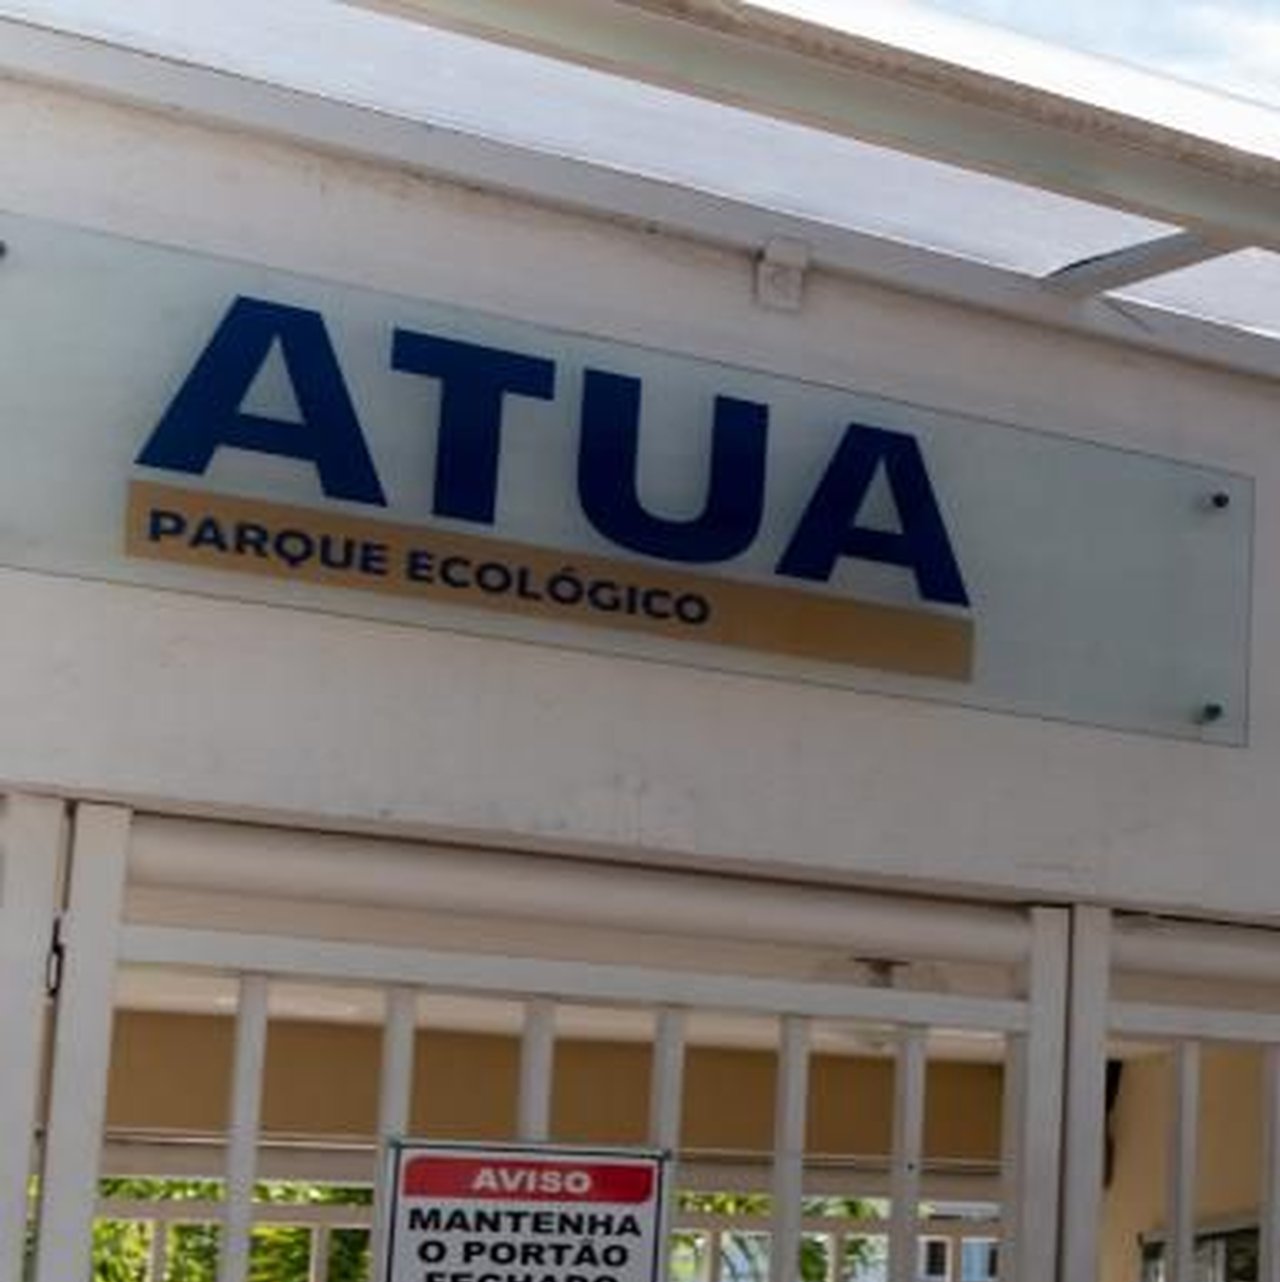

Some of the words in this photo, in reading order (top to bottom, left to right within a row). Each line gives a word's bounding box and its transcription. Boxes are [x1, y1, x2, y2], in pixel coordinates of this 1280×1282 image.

[134, 294, 972, 609] ATUA
[147, 508, 389, 576] PARQUE
[405, 549, 711, 628] ECOLÓGICO
[471, 1167, 592, 1194] AVISO
[408, 1207, 642, 1237] MANTENHA
[417, 1240, 447, 1264] O
[462, 1238, 629, 1267] PORTÃO
